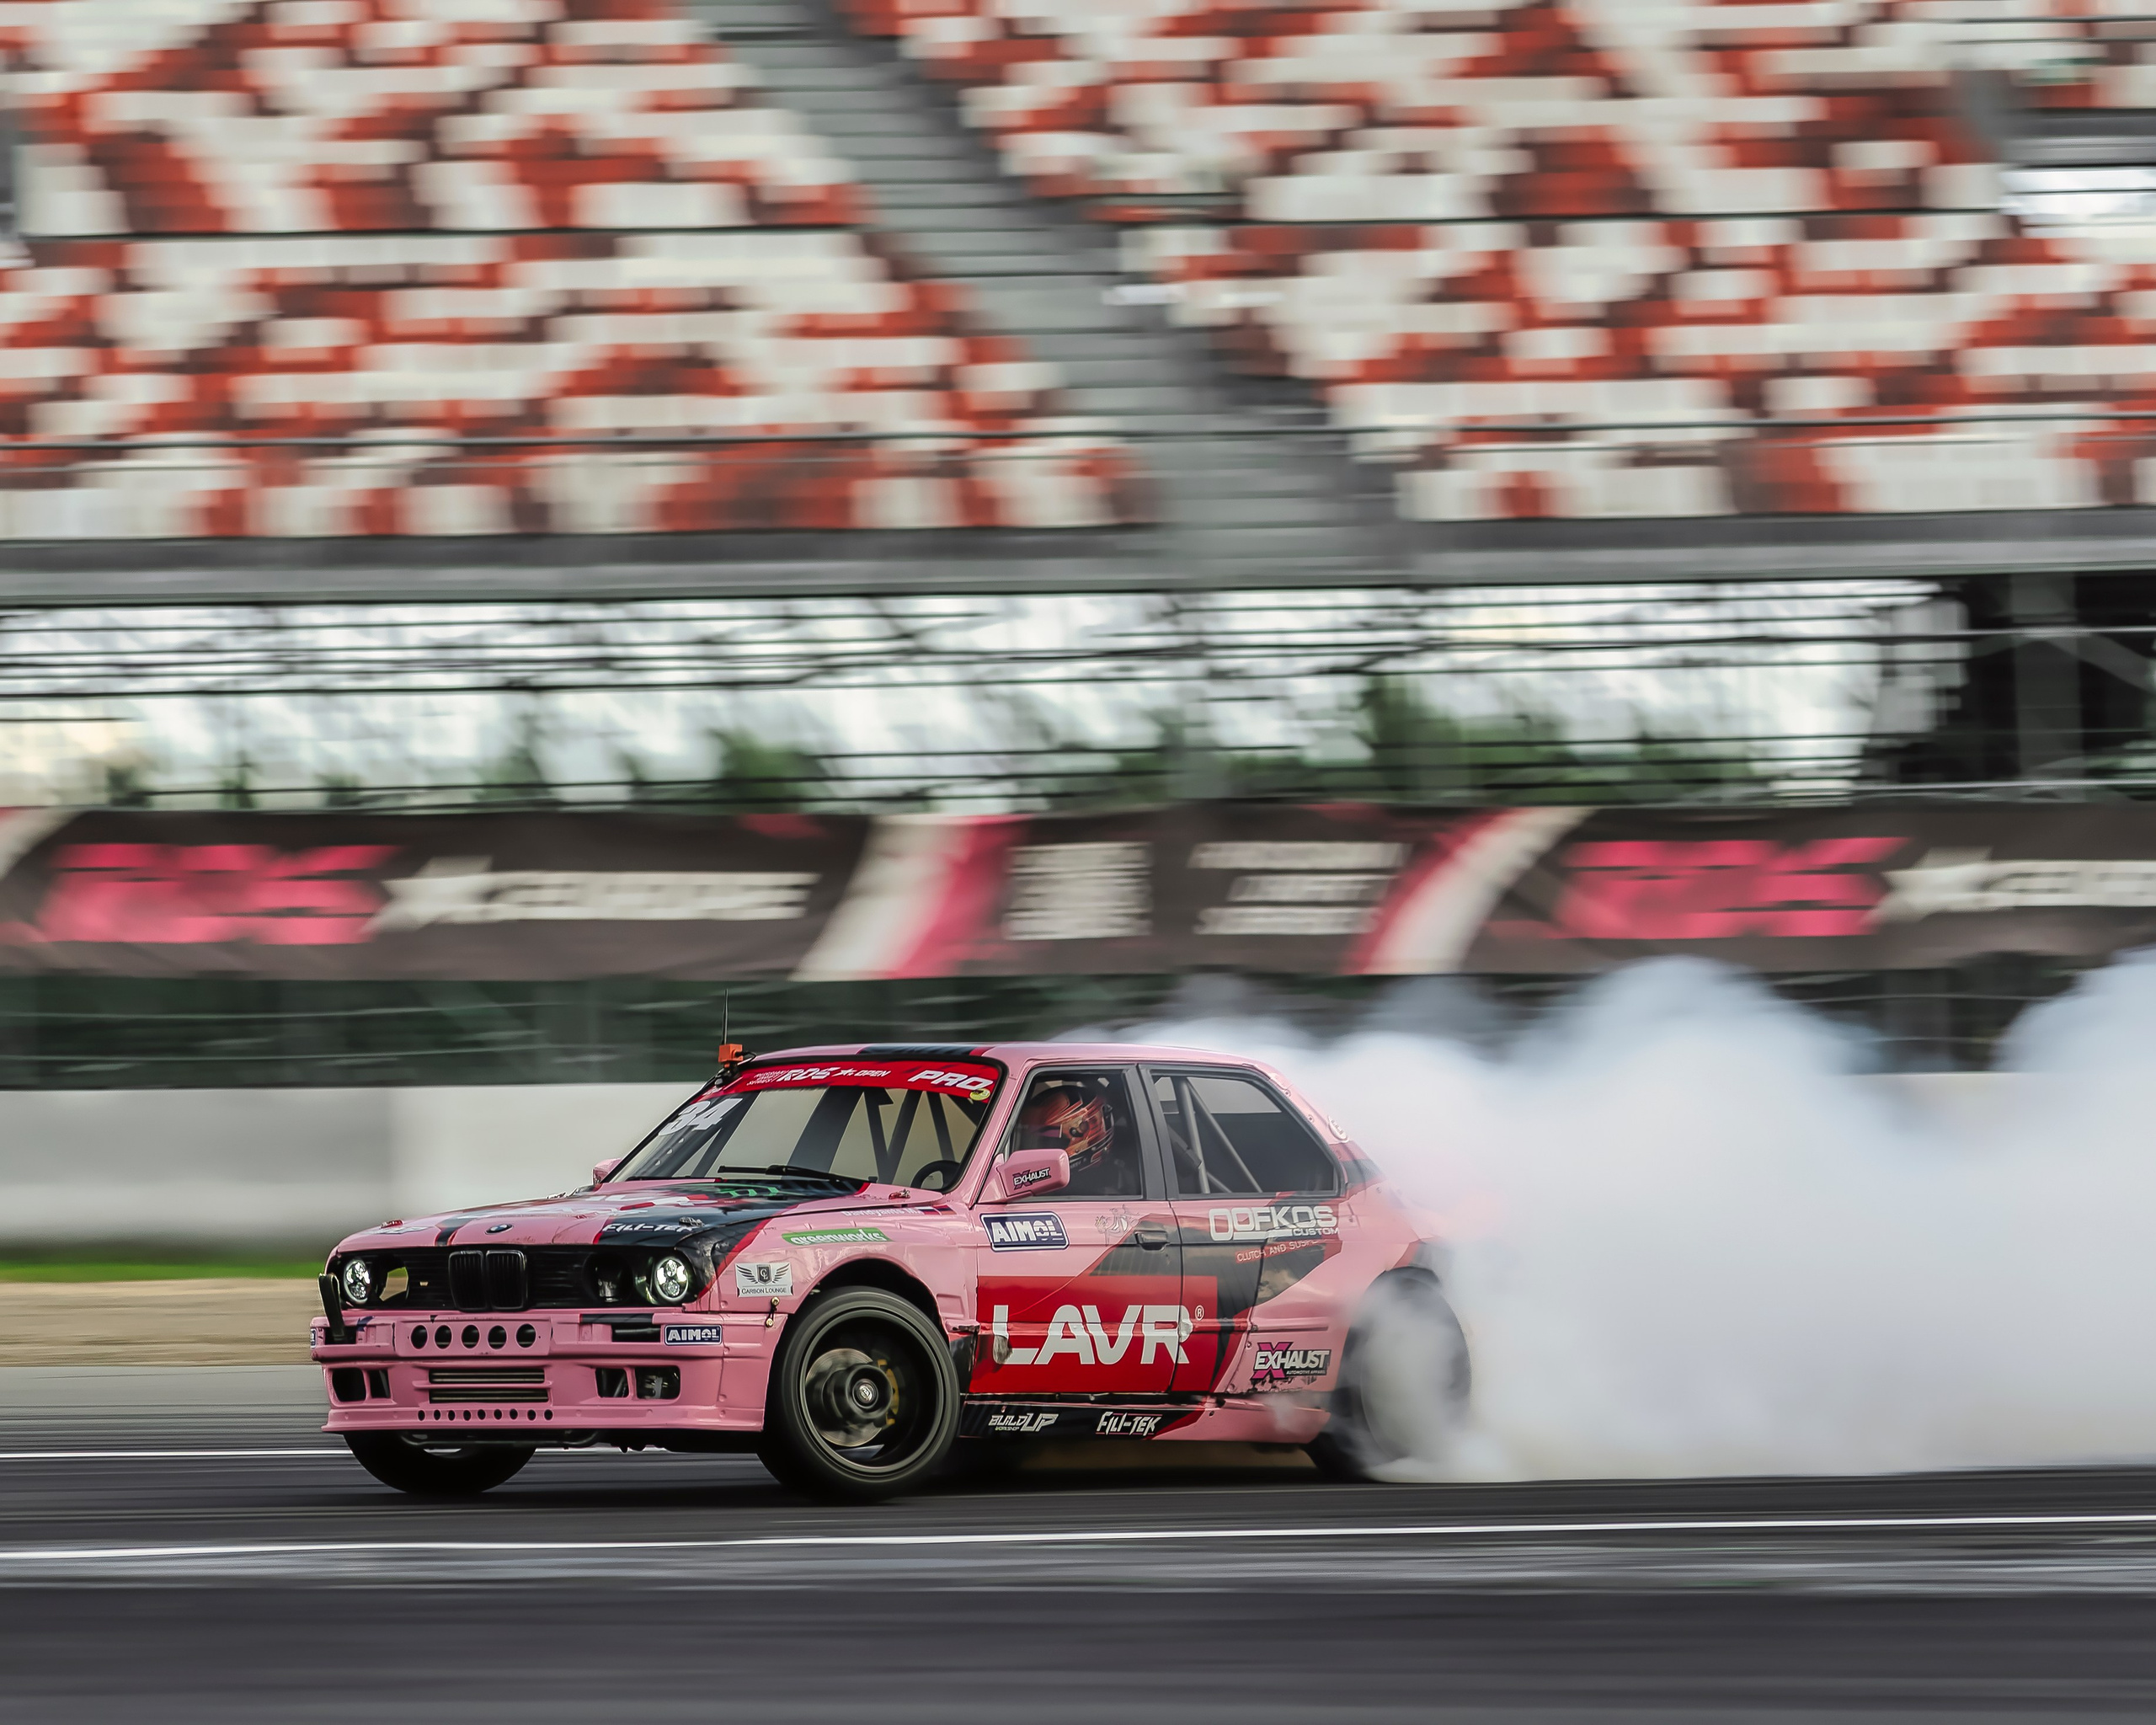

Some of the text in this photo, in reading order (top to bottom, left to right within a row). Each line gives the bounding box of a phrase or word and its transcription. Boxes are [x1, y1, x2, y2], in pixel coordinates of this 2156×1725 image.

[776, 1067, 841, 1082] RDS
[907, 1070, 994, 1090] PRO
[658, 1098, 743, 1135] 34
[1013, 1167, 1051, 1186] EXHAUST
[790, 1229, 888, 1245] greenworks
[991, 1220, 1063, 1242] AIMOL
[1293, 1228, 1339, 1236] CUSTOM
[1236, 1249, 1267, 1262] CLUTCH
[1269, 1243, 1287, 1255] AND
[668, 1328, 719, 1341] AIMOL
[1254, 1350, 1330, 1370] EXHAUST
